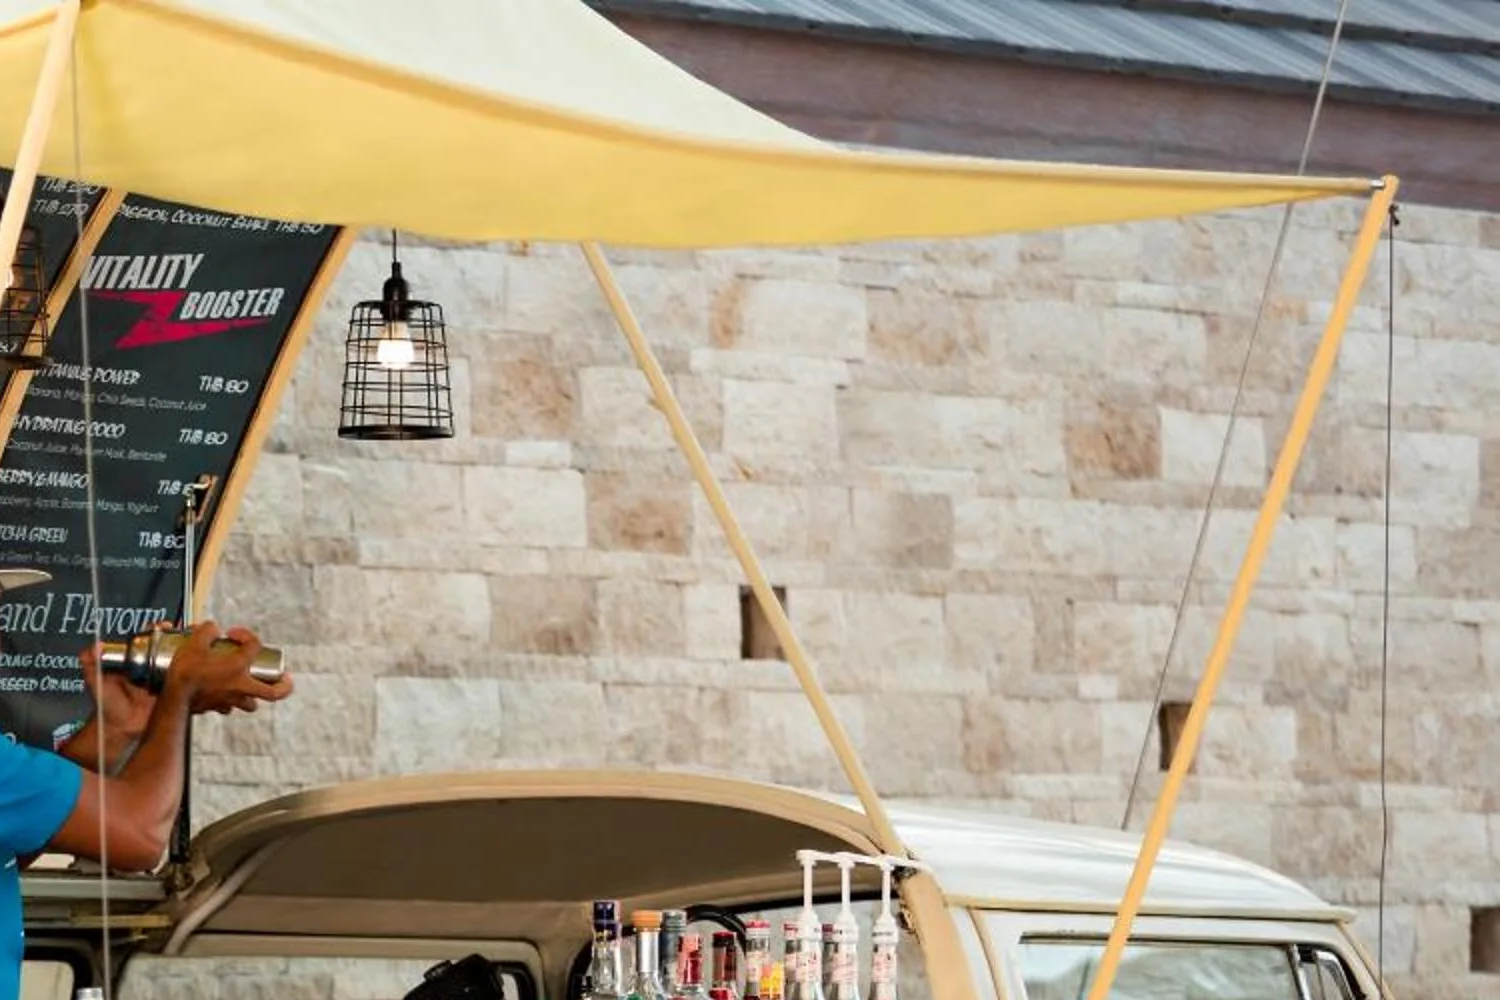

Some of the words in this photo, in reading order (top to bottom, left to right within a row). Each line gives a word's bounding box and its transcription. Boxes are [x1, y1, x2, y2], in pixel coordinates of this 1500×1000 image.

[79, 253, 204, 290] VITALITY
[180, 287, 284, 320] BOOSTER
[96, 364, 141, 386] POWER
[199, 375, 223, 393] THB
[88, 422, 125, 439] COCO
[179, 429, 203, 445] THB
[29, 527, 68, 543] GREEN
